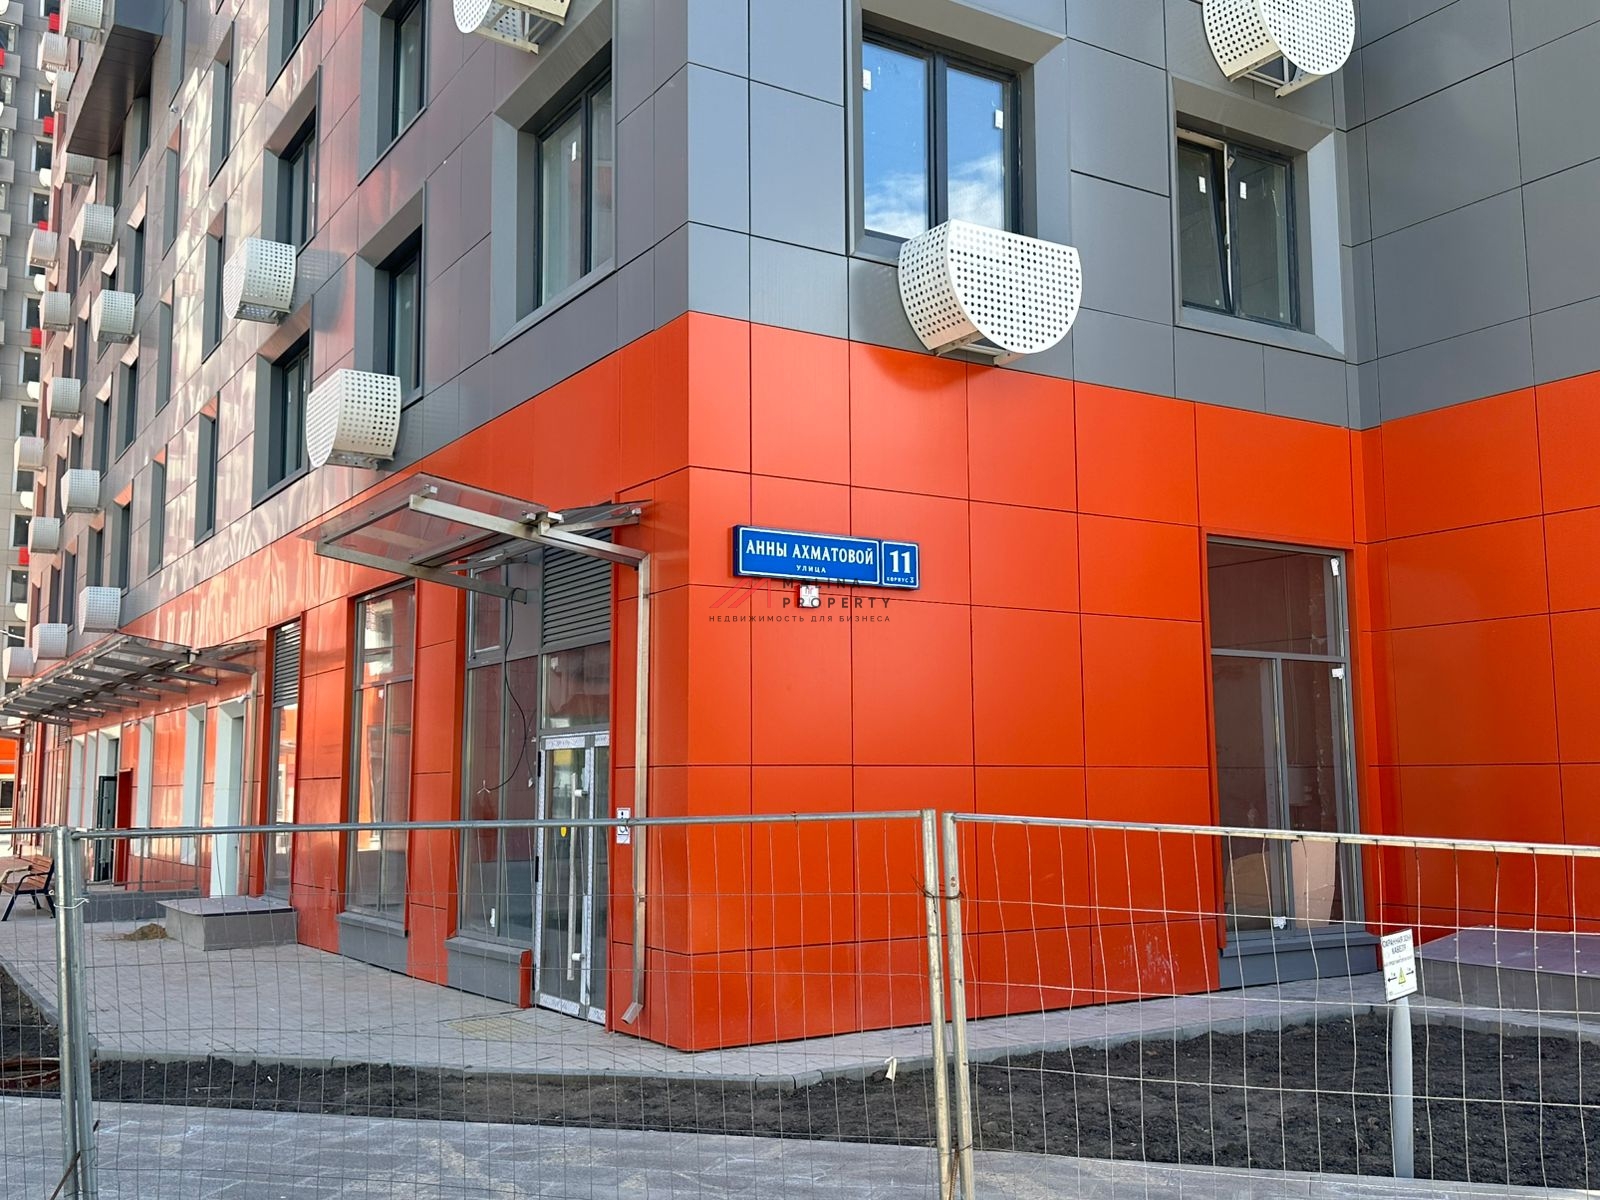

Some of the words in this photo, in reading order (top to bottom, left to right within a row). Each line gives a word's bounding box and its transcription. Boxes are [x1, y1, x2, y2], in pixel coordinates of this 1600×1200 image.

[746, 540, 787, 557] АННЫ
[792, 544, 873, 565] АХМАТОВОЙ
[890, 550, 911, 574] 11
[796, 565, 826, 573] УЛИЦА
